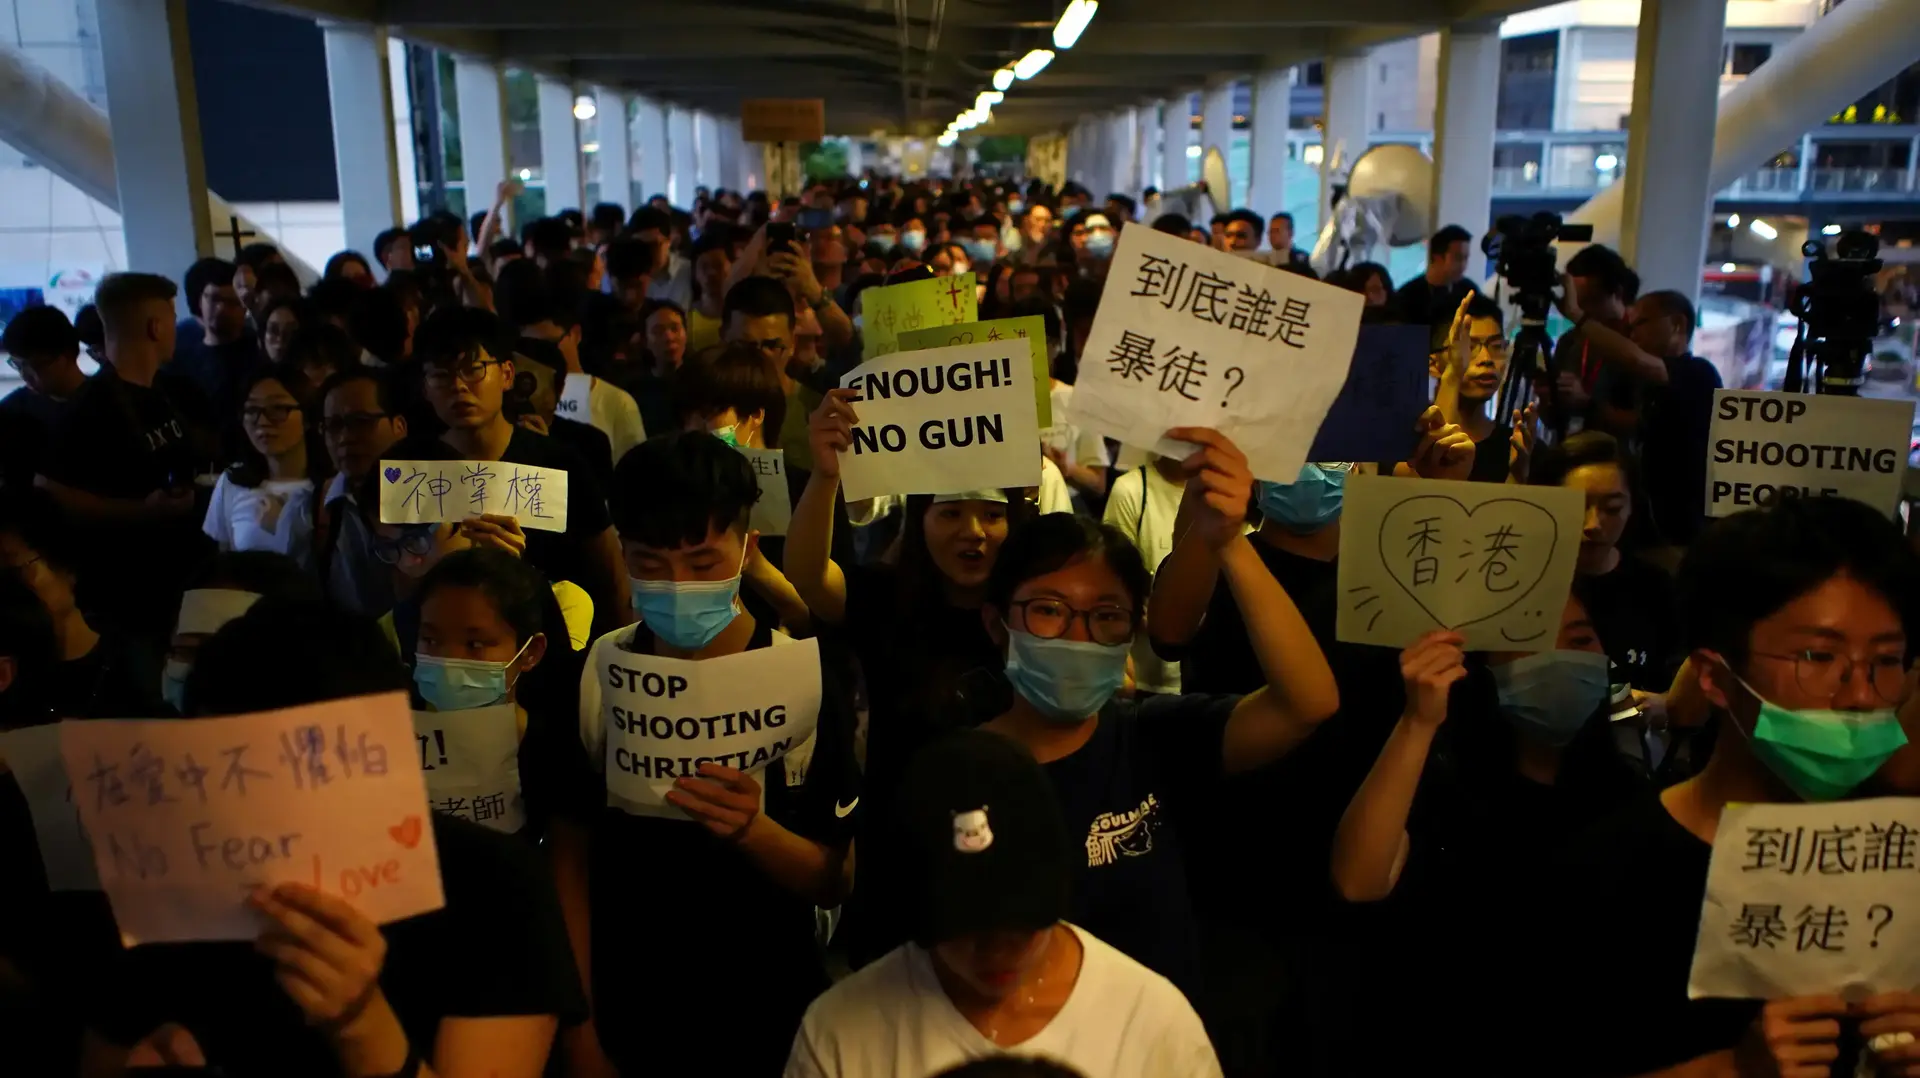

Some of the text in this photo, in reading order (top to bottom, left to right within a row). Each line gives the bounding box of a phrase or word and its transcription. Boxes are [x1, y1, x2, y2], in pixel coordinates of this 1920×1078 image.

[1130, 253, 1311, 350] 到底誰是
[847, 357, 1013, 403] ENOUGH!
[1106, 330, 1245, 408] 暴徒？
[1718, 396, 1807, 424] STOP
[851, 413, 1004, 456] NO GUN
[1713, 439, 1897, 474] SHOOTING
[401, 463, 554, 518] 神掌權
[1406, 516, 1523, 593] 香港
[608, 663, 688, 699] STOP
[612, 704, 787, 740] SHOOTING
[615, 736, 793, 779] CHRISTIAN
[190, 822, 301, 870] Fear
[1741, 820, 1920, 876] 到底誰
[1728, 903, 1894, 952] 暴徒？
